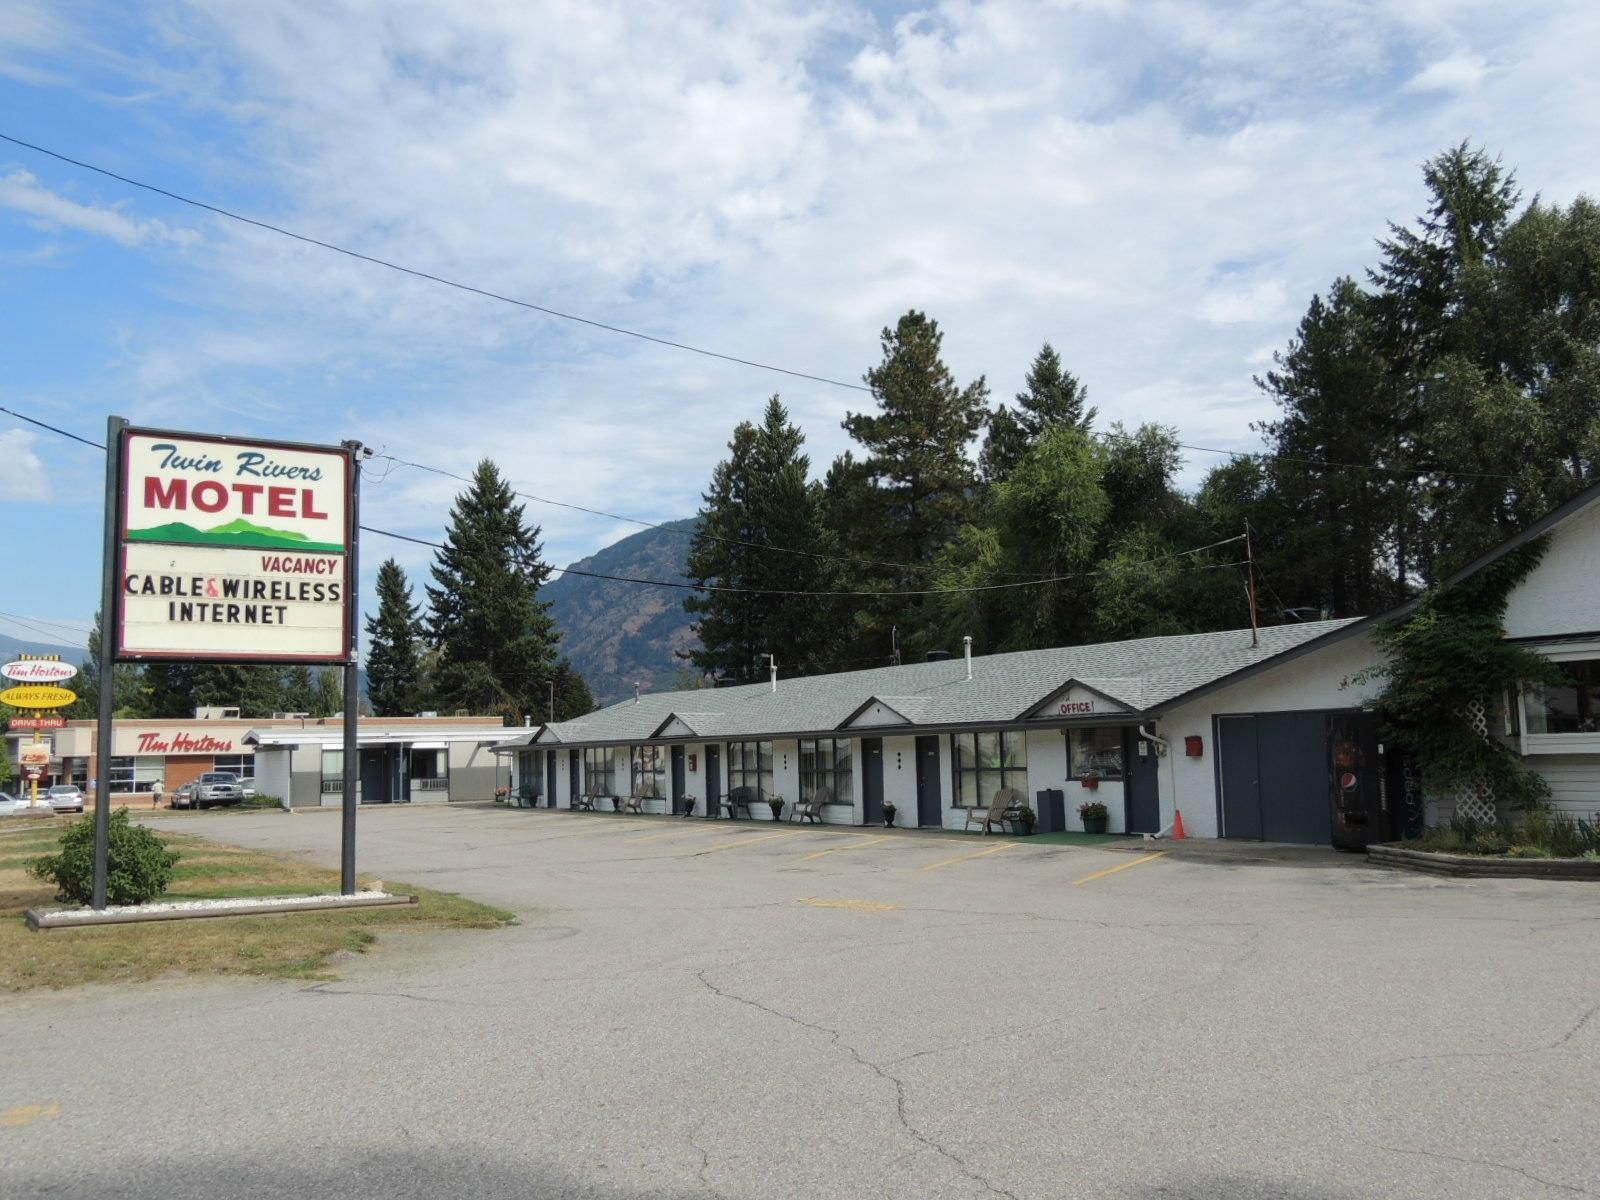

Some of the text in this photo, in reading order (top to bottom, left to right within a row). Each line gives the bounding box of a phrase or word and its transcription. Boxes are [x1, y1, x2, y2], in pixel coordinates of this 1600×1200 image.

[151, 444, 324, 482] Twin Rivers
[143, 476, 329, 520] MOTEL
[261, 556, 338, 575] VACANCY
[168, 601, 288, 625] INTERNET
[7, 663, 73, 677] Tim Hortons
[4, 692, 72, 701] ALWAYS FRESH
[1060, 702, 1091, 714] OFFICE
[11, 719, 63, 727] DRIVE THRU
[137, 731, 233, 753] Tim Hortons
